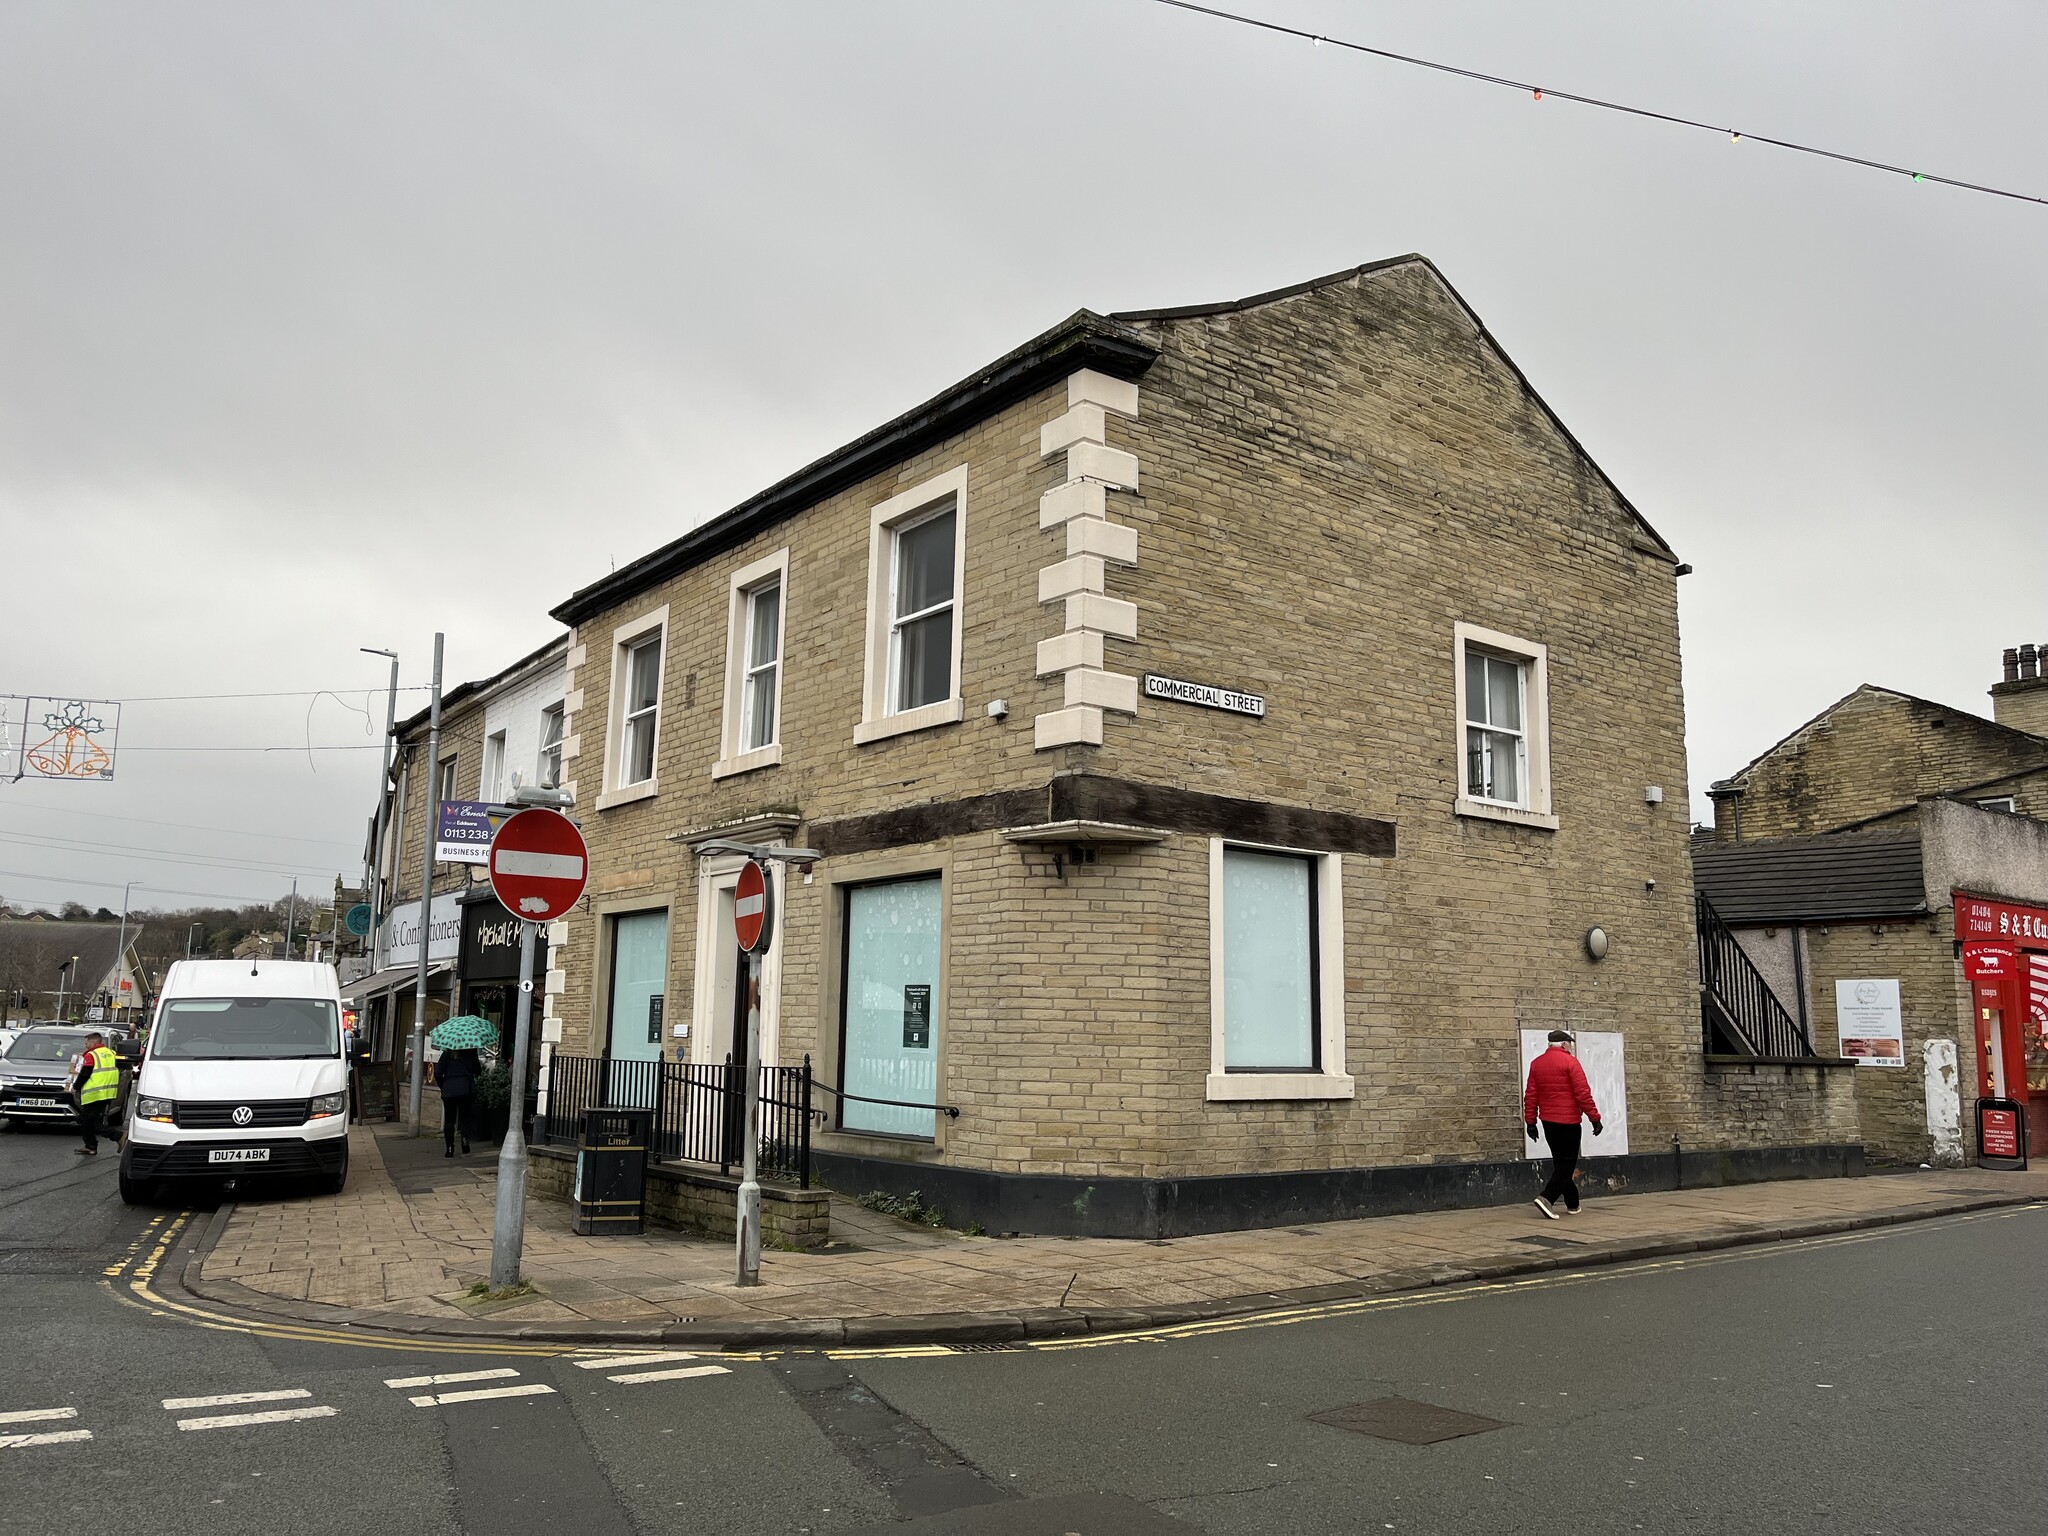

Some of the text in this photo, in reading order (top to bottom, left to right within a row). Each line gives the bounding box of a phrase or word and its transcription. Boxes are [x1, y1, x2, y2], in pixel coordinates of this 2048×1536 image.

[1149, 678, 1262, 713] COMMERCIAL STREET
[444, 828, 466, 839] 0113
[468, 829, 489, 840] 238
[442, 847, 480, 857] BUSINESS
[1999, 911, 2009, 934] S
[2011, 913, 2020, 936] &
[391, 924, 399, 948] &
[400, 914, 461, 947] Conftioners
[608, 1138, 631, 1146] Litter
[213, 1149, 266, 1161] DU74 ABK
